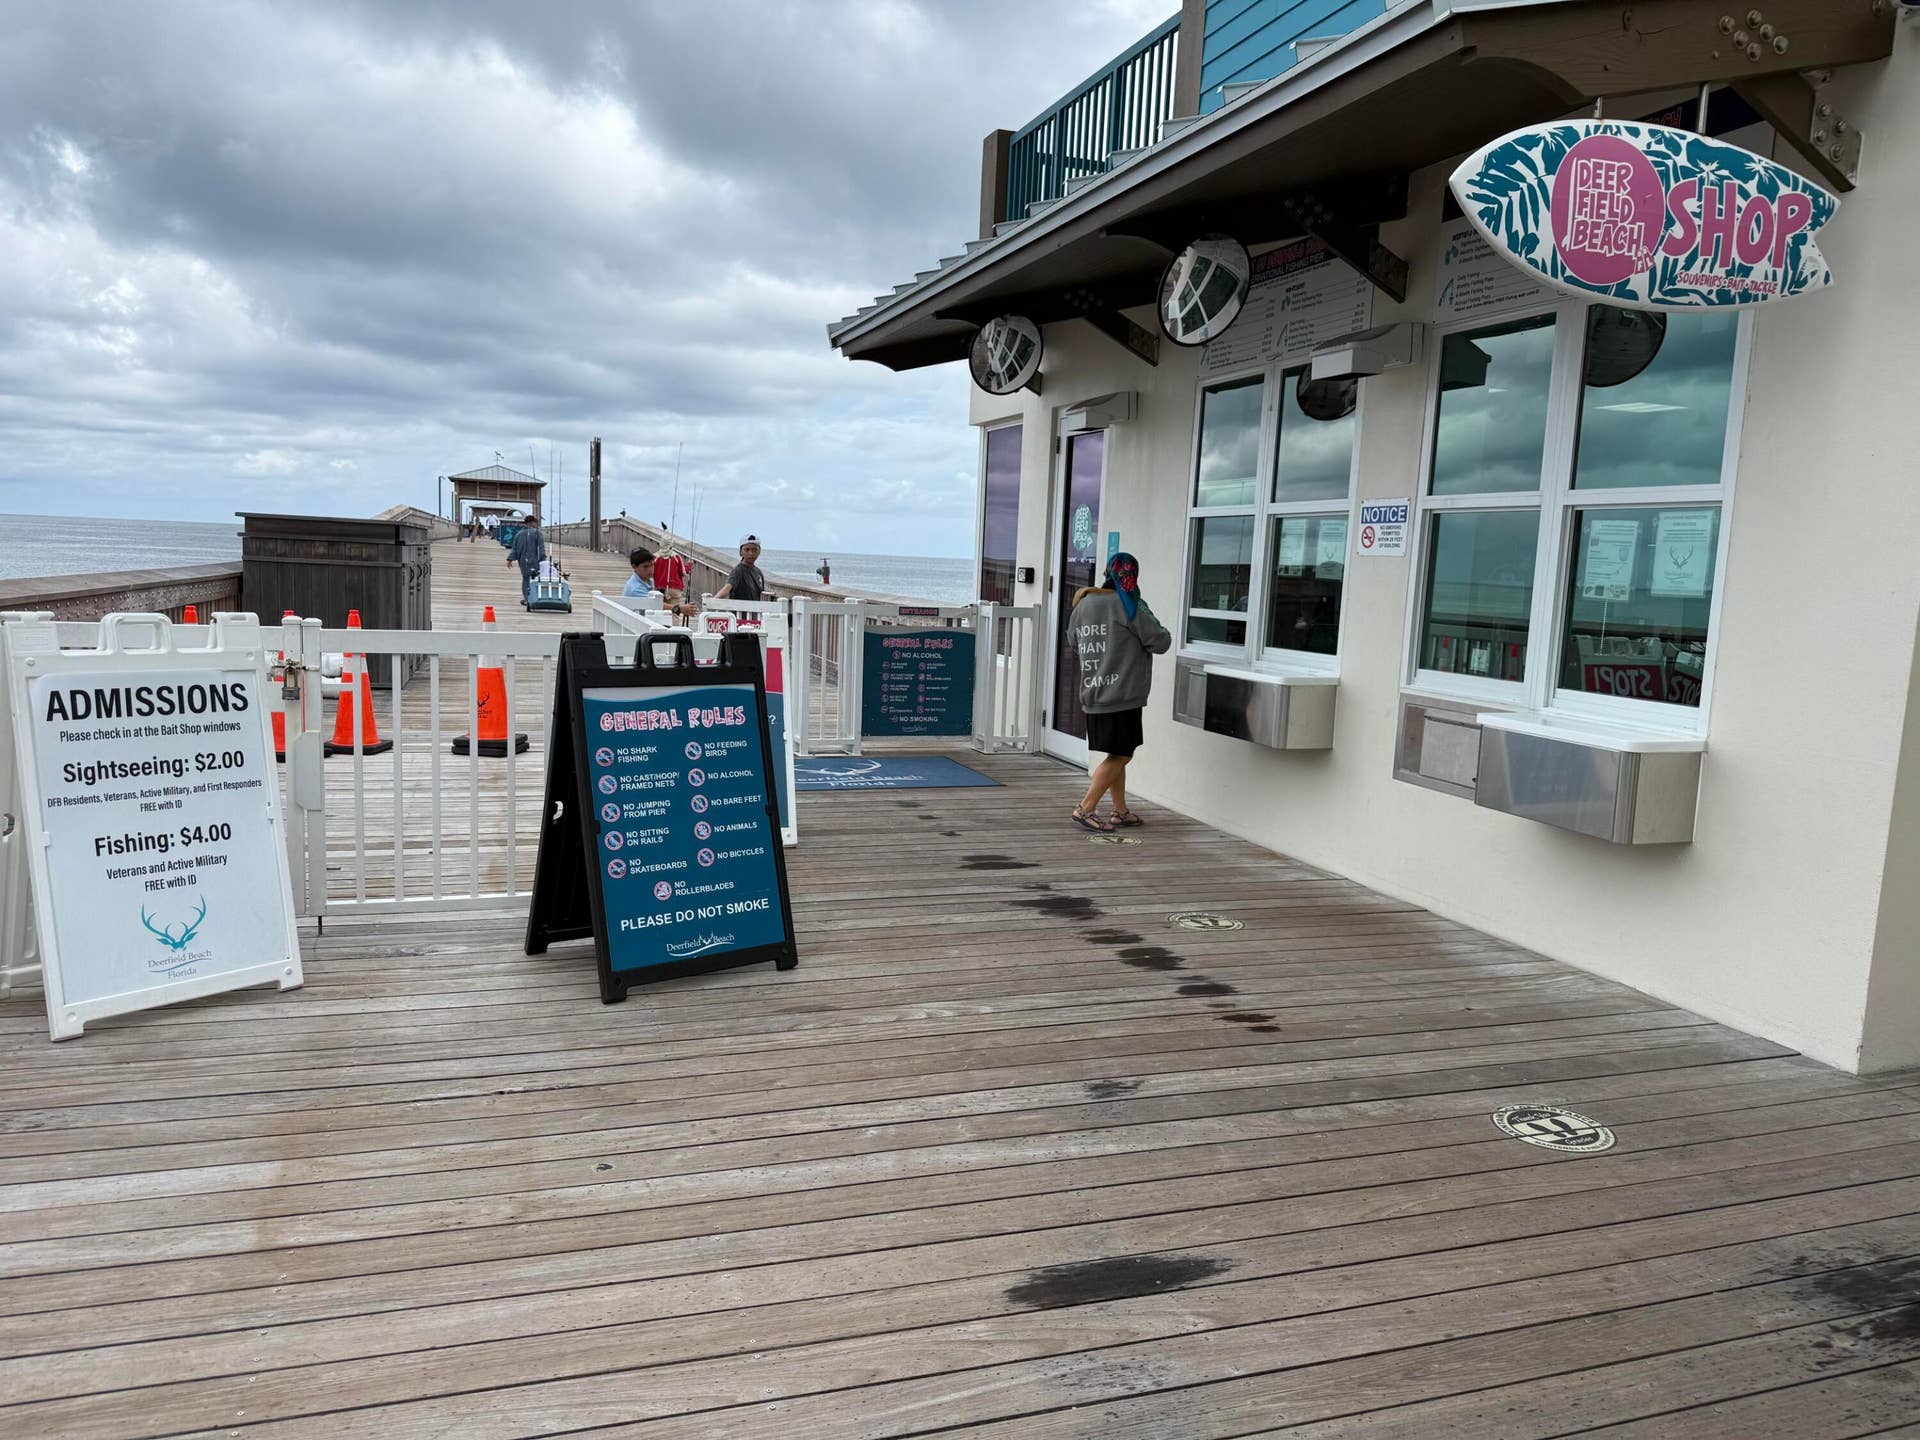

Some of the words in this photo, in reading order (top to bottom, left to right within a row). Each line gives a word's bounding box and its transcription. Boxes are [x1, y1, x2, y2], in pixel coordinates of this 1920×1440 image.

[1577, 159, 1633, 195] DEER
[1575, 190, 1634, 223] FIELD
[1662, 178, 1812, 269] SHOP
[1571, 220, 1645, 259] BEACH
[1678, 271, 1722, 288] SOUVENIRS
[1728, 277, 1746, 291] BAIT
[1750, 280, 1778, 294] TACKLE
[1363, 507, 1406, 522] NOTICE
[46, 682, 249, 722] ADMISSIONS
[600, 709, 683, 732] GENERAL
[688, 706, 745, 728] RULES
[60, 730, 91, 743] Please
[93, 726, 121, 740] check
[123, 726, 131, 738] in
[133, 727, 143, 738] at
[144, 724, 159, 737] the
[161, 723, 178, 736] Bait
[180, 722, 201, 738] Shop
[203, 720, 241, 734] windows
[617, 748, 629, 756] NO
[630, 746, 657, 755] SHARK
[704, 742, 715, 750] NO
[716, 740, 747, 749] FEEDING
[618, 754, 649, 763] FISHING
[705, 749, 727, 757] BIRDS
[63, 755, 190, 786] Sightseeing:
[195, 750, 244, 773] $2.00
[708, 772, 719, 780] NO
[720, 769, 753, 779] ALCOHOL
[620, 775, 632, 783] NO
[620, 782, 654, 791] FRAMED
[655, 779, 675, 788] NETS
[47, 797, 61, 808] DFB
[63, 794, 103, 806] Residents,
[103, 790, 139, 801] Veterans,
[140, 788, 162, 798] Active
[163, 785, 192, 797] Military,
[193, 782, 206, 793] and
[207, 780, 222, 791] First
[223, 778, 262, 792] Responders
[723, 796, 743, 805] BARE
[744, 794, 761, 803] FEET
[140, 802, 157, 813] FREE
[158, 800, 174, 812] with
[175, 799, 183, 809] ID
[623, 803, 635, 811] NO
[636, 799, 671, 810] JUMPING
[624, 810, 647, 819] FROM
[648, 808, 666, 816] PIER
[639, 827, 670, 837] SITTING
[714, 825, 725, 833] NO
[726, 821, 758, 831] ANIMALS
[94, 832, 175, 857] Fishing:
[180, 822, 231, 847] $4.00
[627, 838, 639, 847] ON
[640, 836, 664, 845] RAILS
[717, 851, 728, 859] NO
[729, 847, 765, 858] BICYCLES
[106, 864, 148, 880] Veterans
[149, 861, 166, 875] and
[167, 857, 194, 871] Active
[195, 853, 228, 868] Military
[629, 858, 641, 866] NO
[630, 861, 688, 875] SKATEBOARDS
[144, 879, 165, 892] FREE
[166, 876, 187, 889] with
[187, 874, 197, 886] ID
[674, 880, 686, 889] NO
[675, 881, 735, 896] ROLLERBLADES
[620, 912, 673, 932] PLEASE
[676, 910, 694, 923] DO
[697, 905, 723, 920] NOT
[726, 898, 770, 915] SMOKE
[666, 938, 701, 952] Deerfield
[713, 933, 735, 944] Beach
